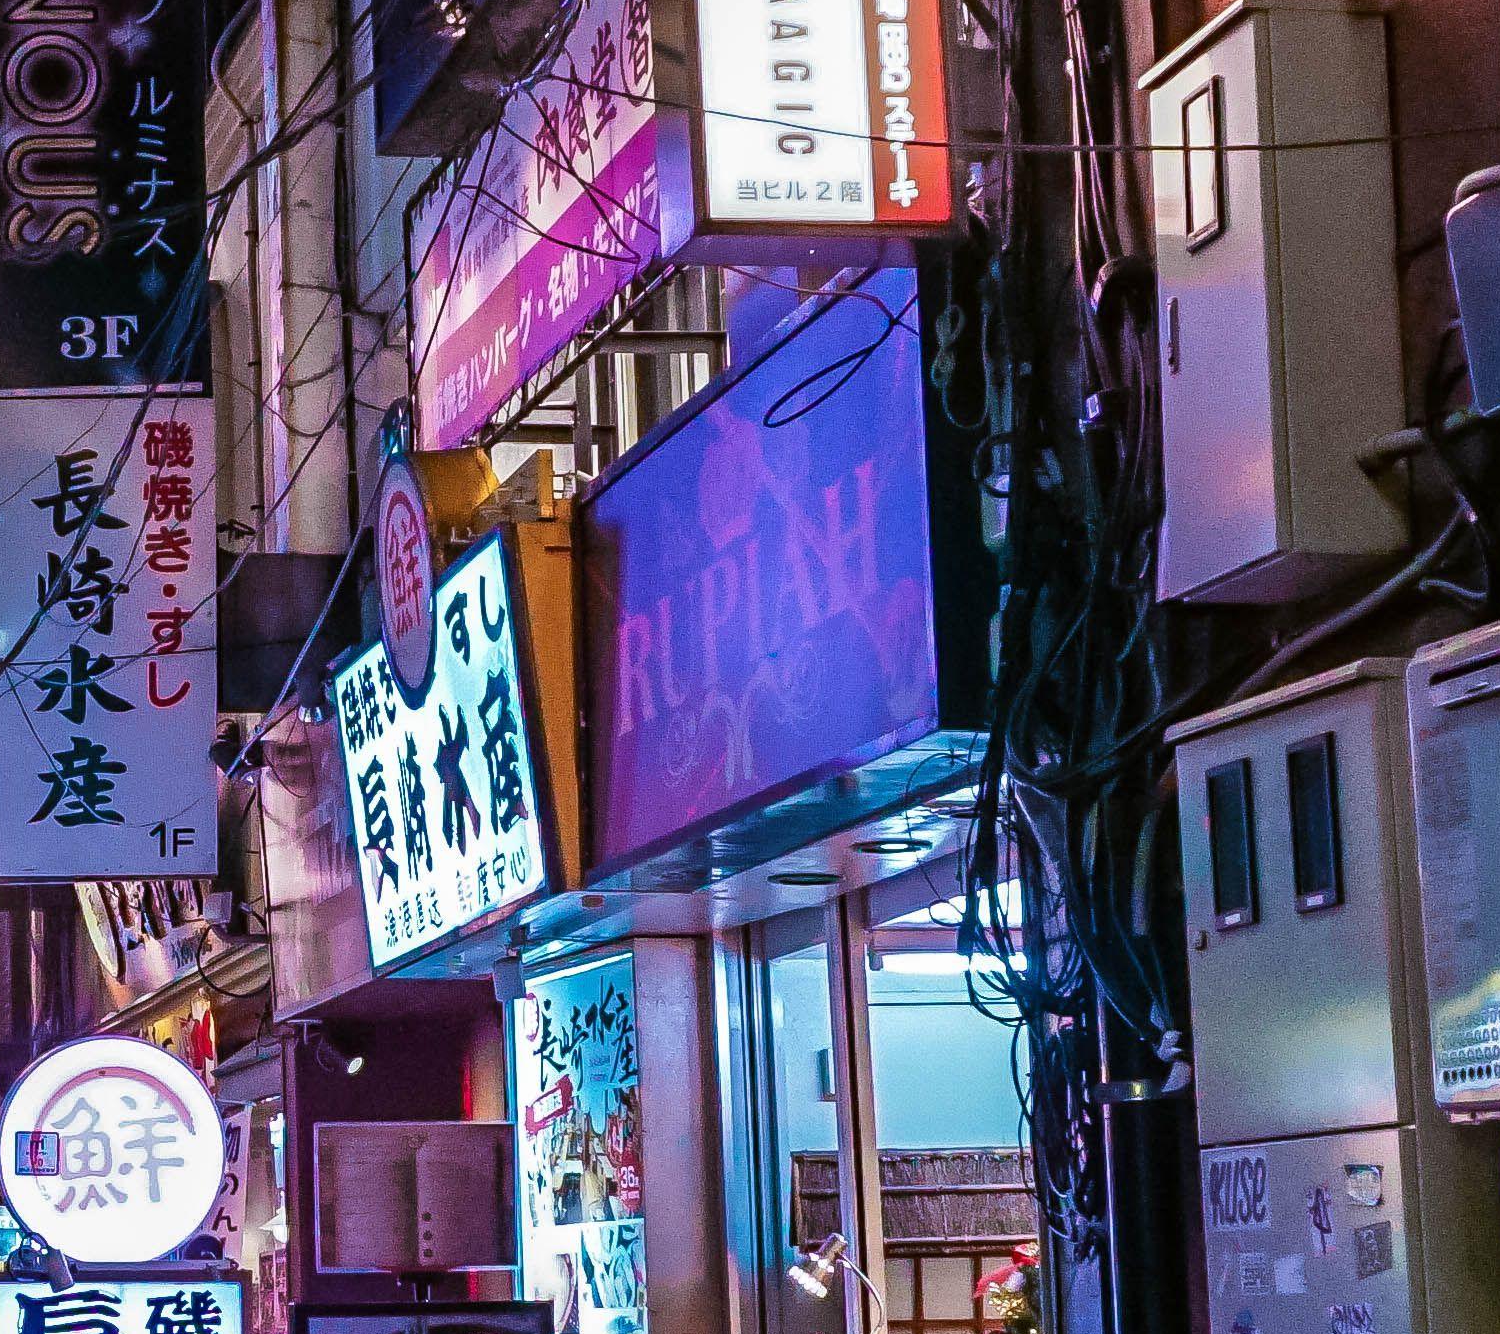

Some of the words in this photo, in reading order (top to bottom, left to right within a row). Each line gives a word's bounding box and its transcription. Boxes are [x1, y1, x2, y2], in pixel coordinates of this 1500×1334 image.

[127, 74, 177, 259] ルミナス
[737, 179, 863, 204] 当ビル2階
[60, 314, 140, 359] 3F
[143, 420, 196, 710] 磯焼き・すし
[444, 575, 506, 665] すし
[29, 449, 136, 828] 長崎水産
[150, 823, 196, 858] 1F
[355, 668, 528, 906] 長崎水産
[51, 1093, 186, 1214] 鮮
